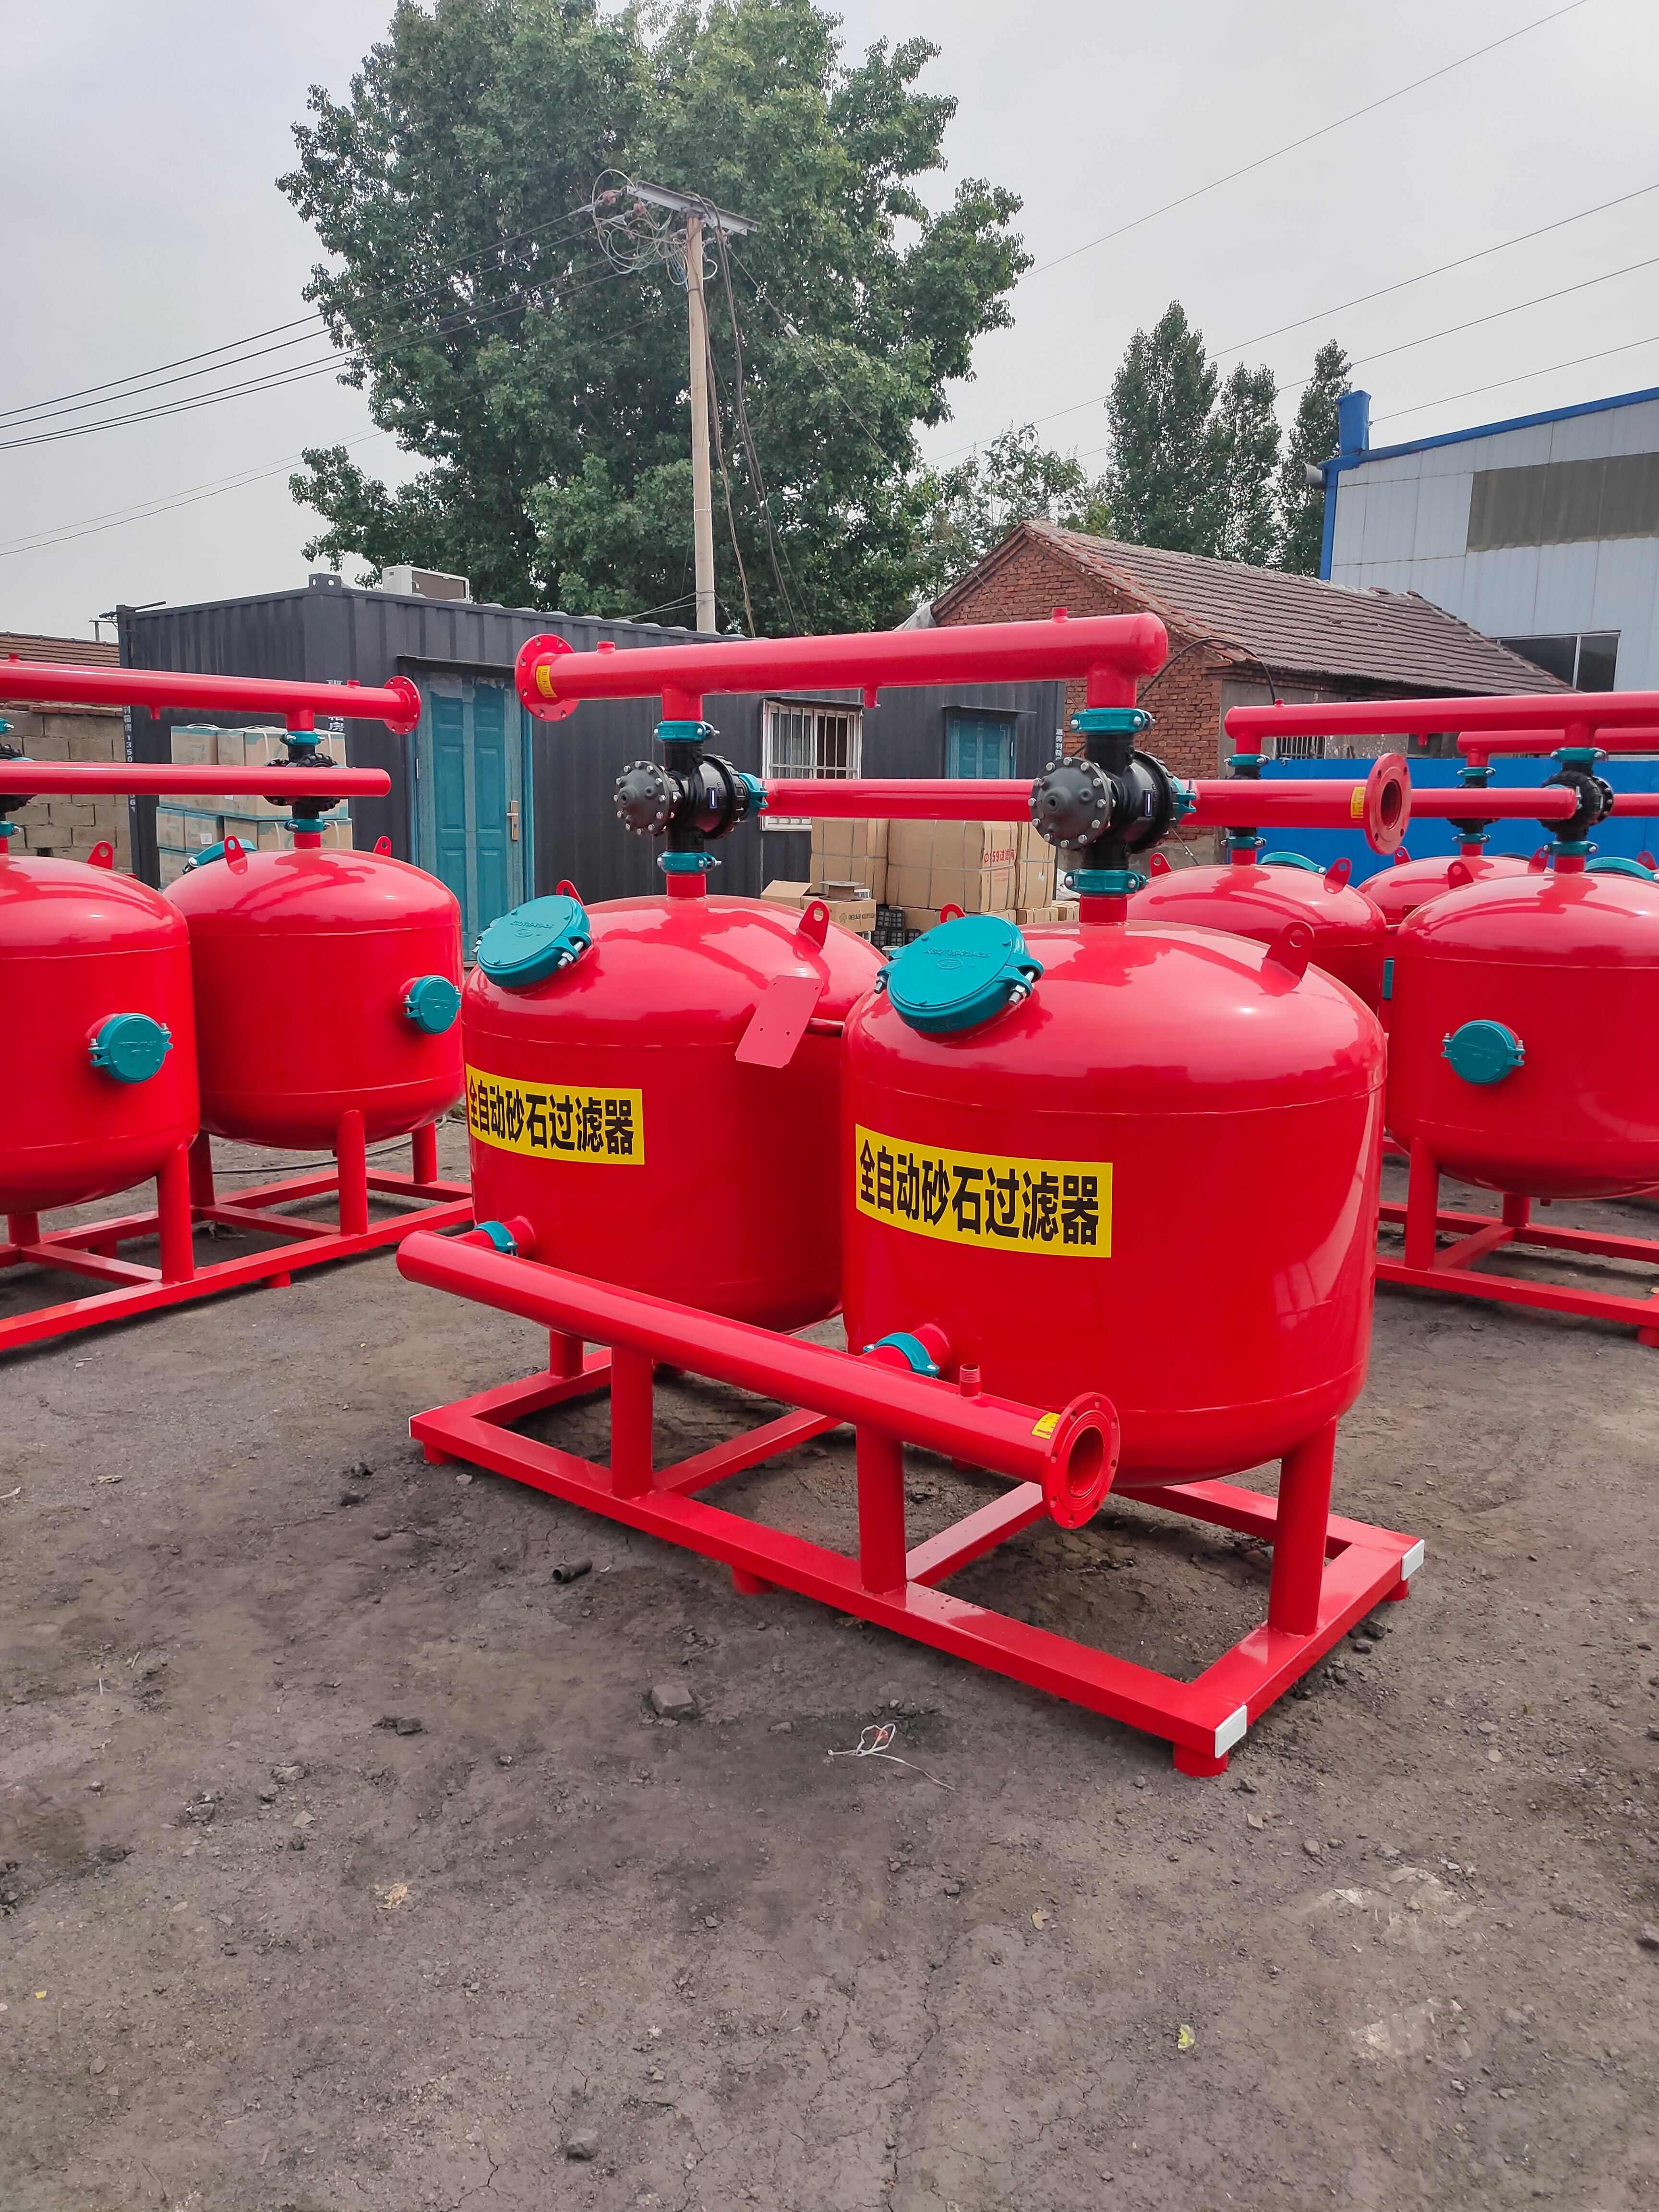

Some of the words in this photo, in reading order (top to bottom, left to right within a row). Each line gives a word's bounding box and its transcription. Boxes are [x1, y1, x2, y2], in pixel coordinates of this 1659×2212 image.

[469, 1075, 634, 1155] 全自动砂石过滤器
[860, 1139, 1099, 1245] 全自动砂石过滤器
